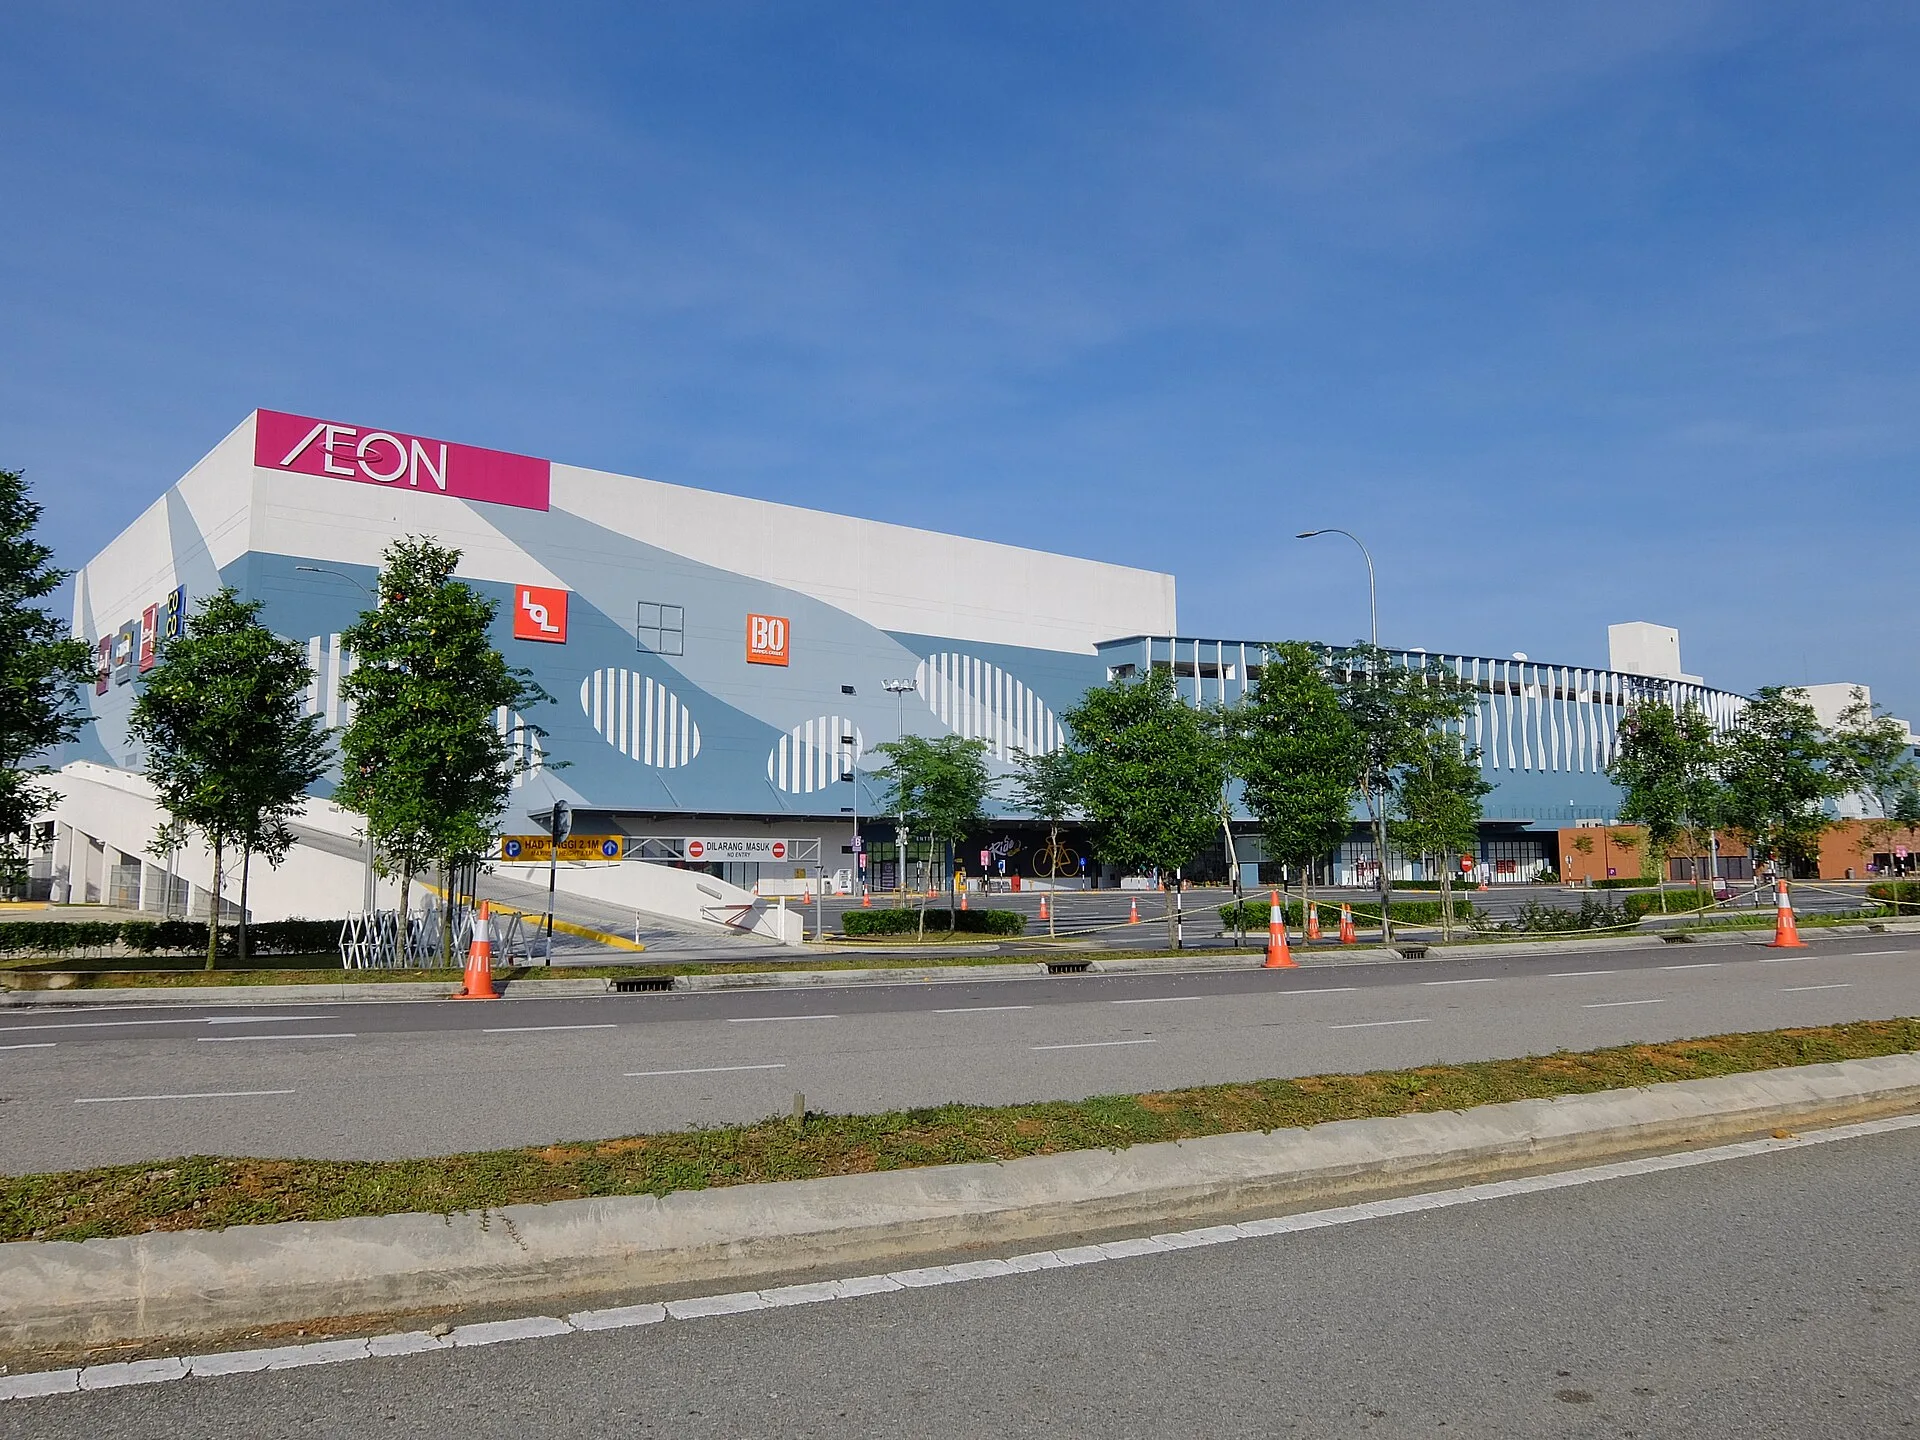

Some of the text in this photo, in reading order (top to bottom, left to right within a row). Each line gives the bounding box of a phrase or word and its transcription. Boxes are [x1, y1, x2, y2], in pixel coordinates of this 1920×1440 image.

[751, 616, 784, 651] BO
[524, 839, 599, 850] HAD TNGGI 2.1M
[706, 841, 770, 851] DILARANG MASUK
